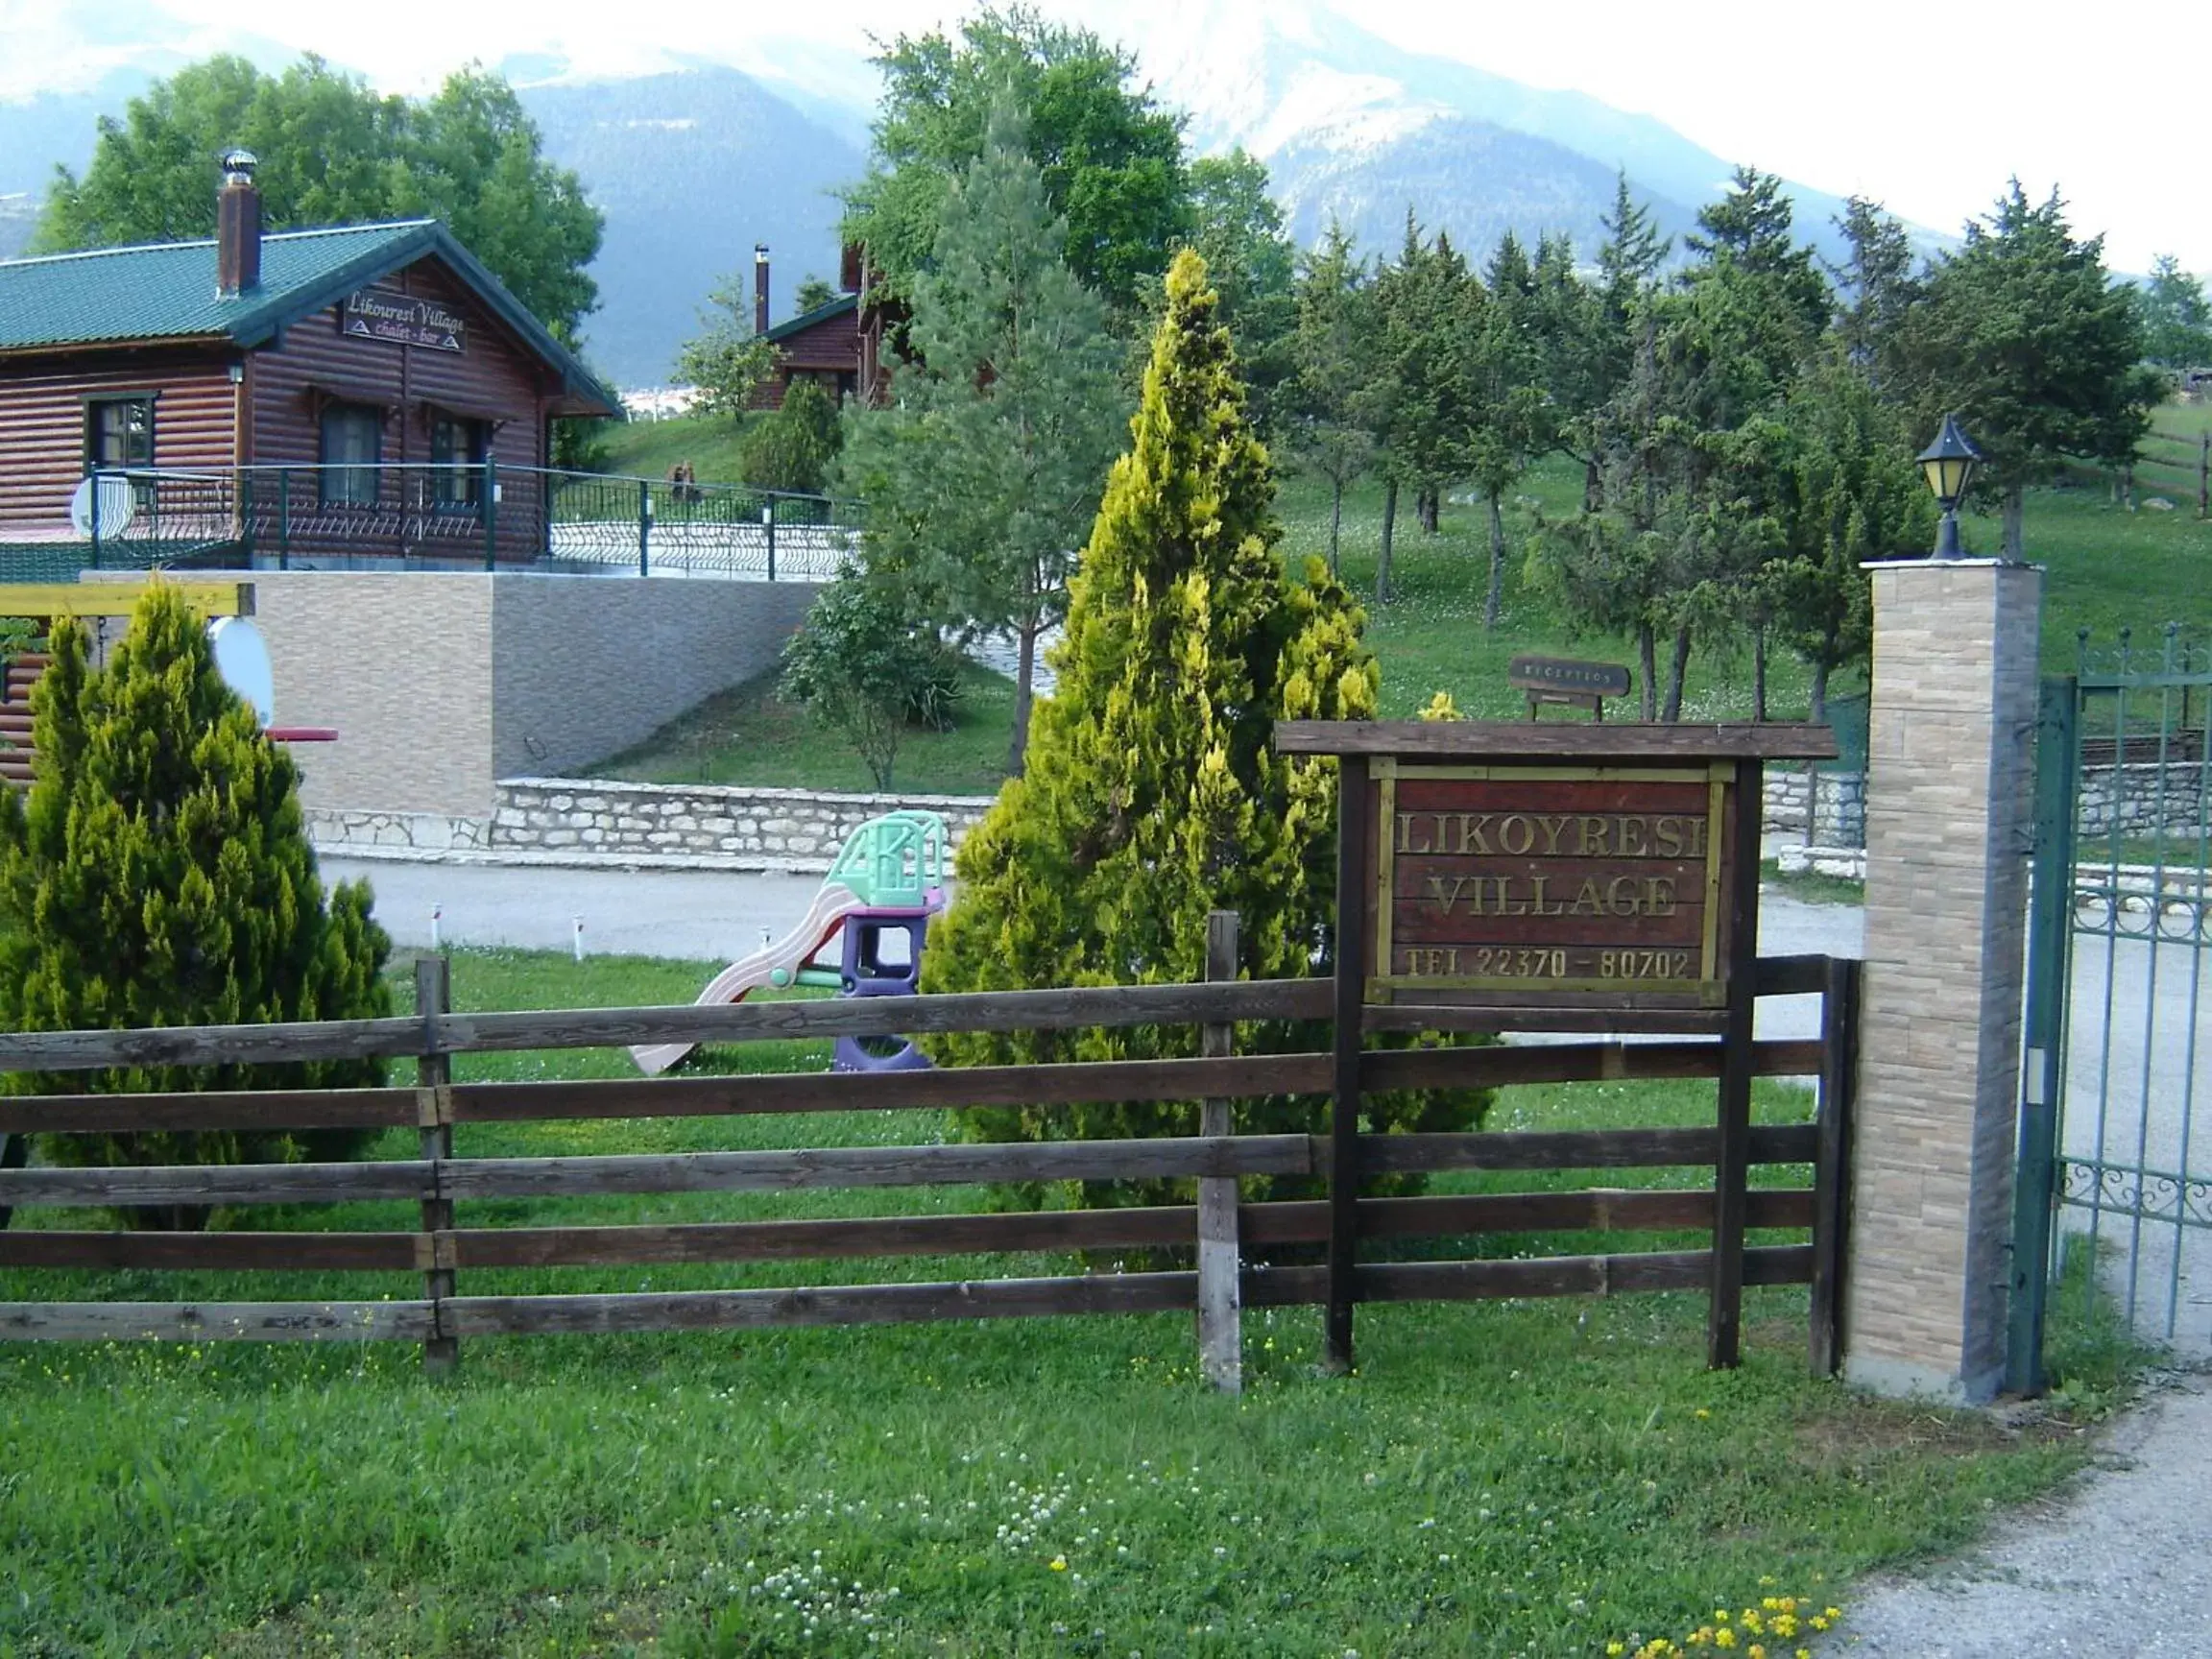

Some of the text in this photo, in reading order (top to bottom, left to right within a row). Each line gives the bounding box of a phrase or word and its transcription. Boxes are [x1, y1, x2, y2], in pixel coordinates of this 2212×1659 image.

[375, 321, 411, 341] chalet
[420, 327, 440, 344] bar
[418, 302, 464, 334] Village
[1428, 876, 1676, 917] VILLAGE
[1476, 947, 1566, 977] 22370
[1600, 950, 1689, 979] 80702
